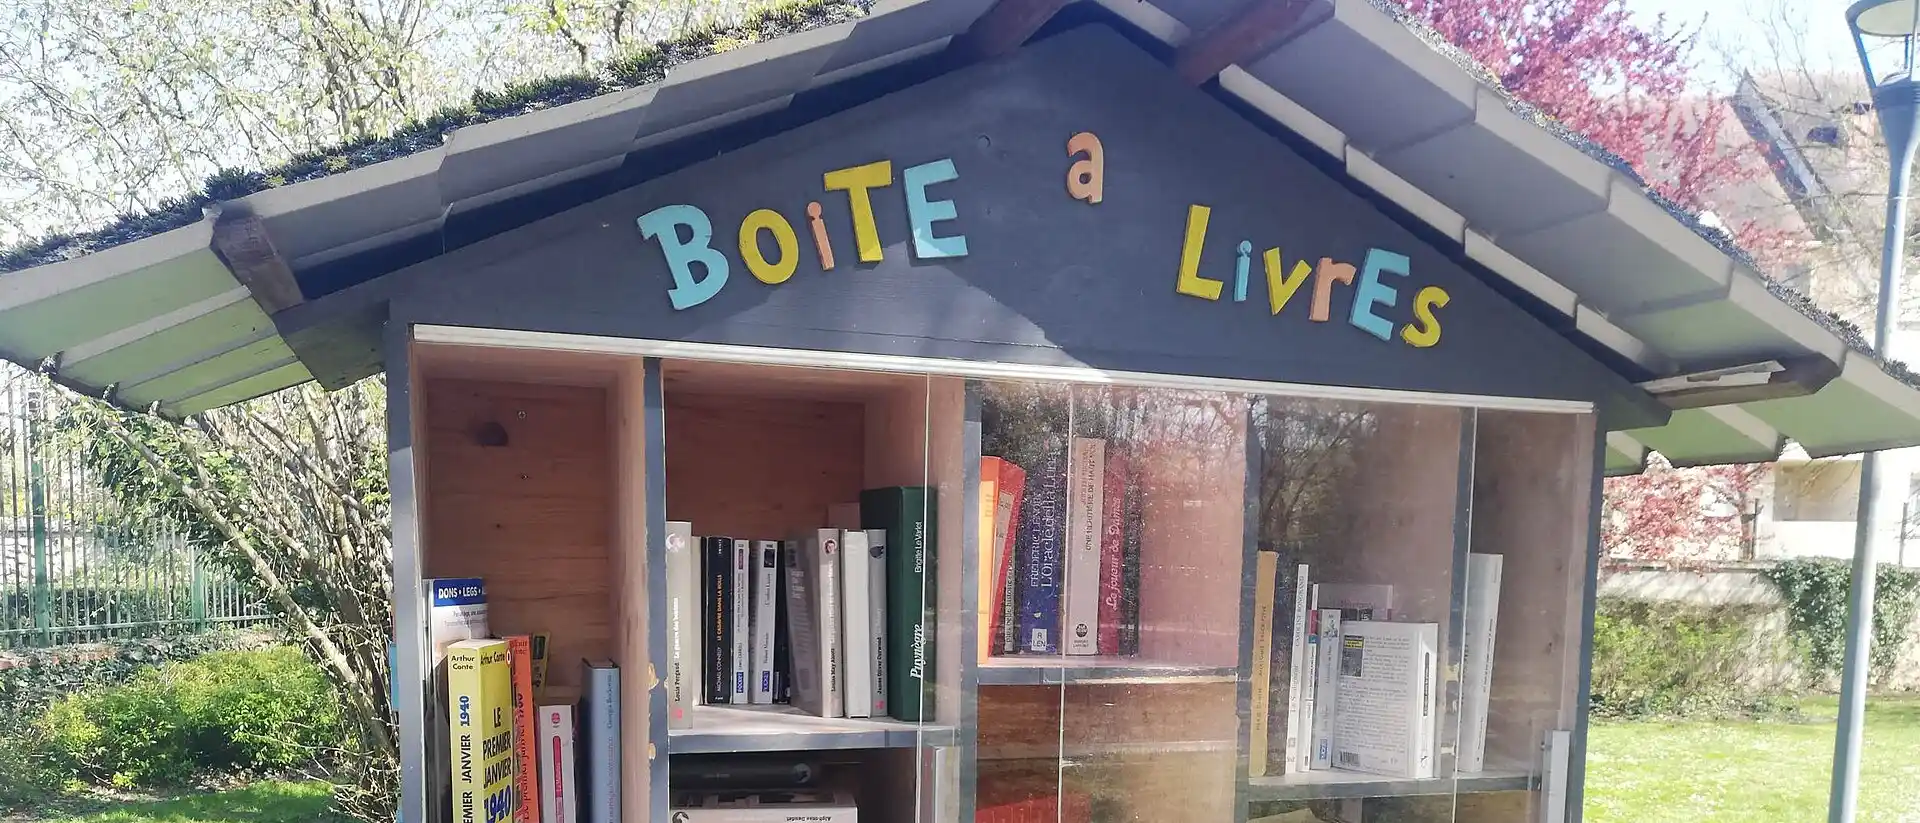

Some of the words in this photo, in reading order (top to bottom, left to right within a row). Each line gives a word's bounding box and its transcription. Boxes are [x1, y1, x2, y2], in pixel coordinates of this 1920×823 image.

[1067, 131, 1105, 204] a
[1108, 497, 1121, 534] Dames
[914, 521, 922, 540] Varlet
[915, 541, 922, 549] Le
[1109, 539, 1120, 552] de
[914, 550, 924, 573] Brigitte
[1109, 554, 1121, 592] joueur
[438, 587, 458, 599] DONS
[463, 586, 478, 597] LEGS
[1106, 591, 1118, 610] Le
[451, 655, 475, 663] Arthur
[480, 653, 493, 665] Arthur
[494, 651, 506, 663] Conte
[910, 623, 925, 679] Puynègre
[459, 695, 471, 727] 1940
[494, 707, 502, 729] LE
[461, 734, 472, 784] JANVIER
[482, 730, 511, 761] PREMIER
[483, 757, 512, 789] JANVIER
[484, 785, 512, 823] 1940
